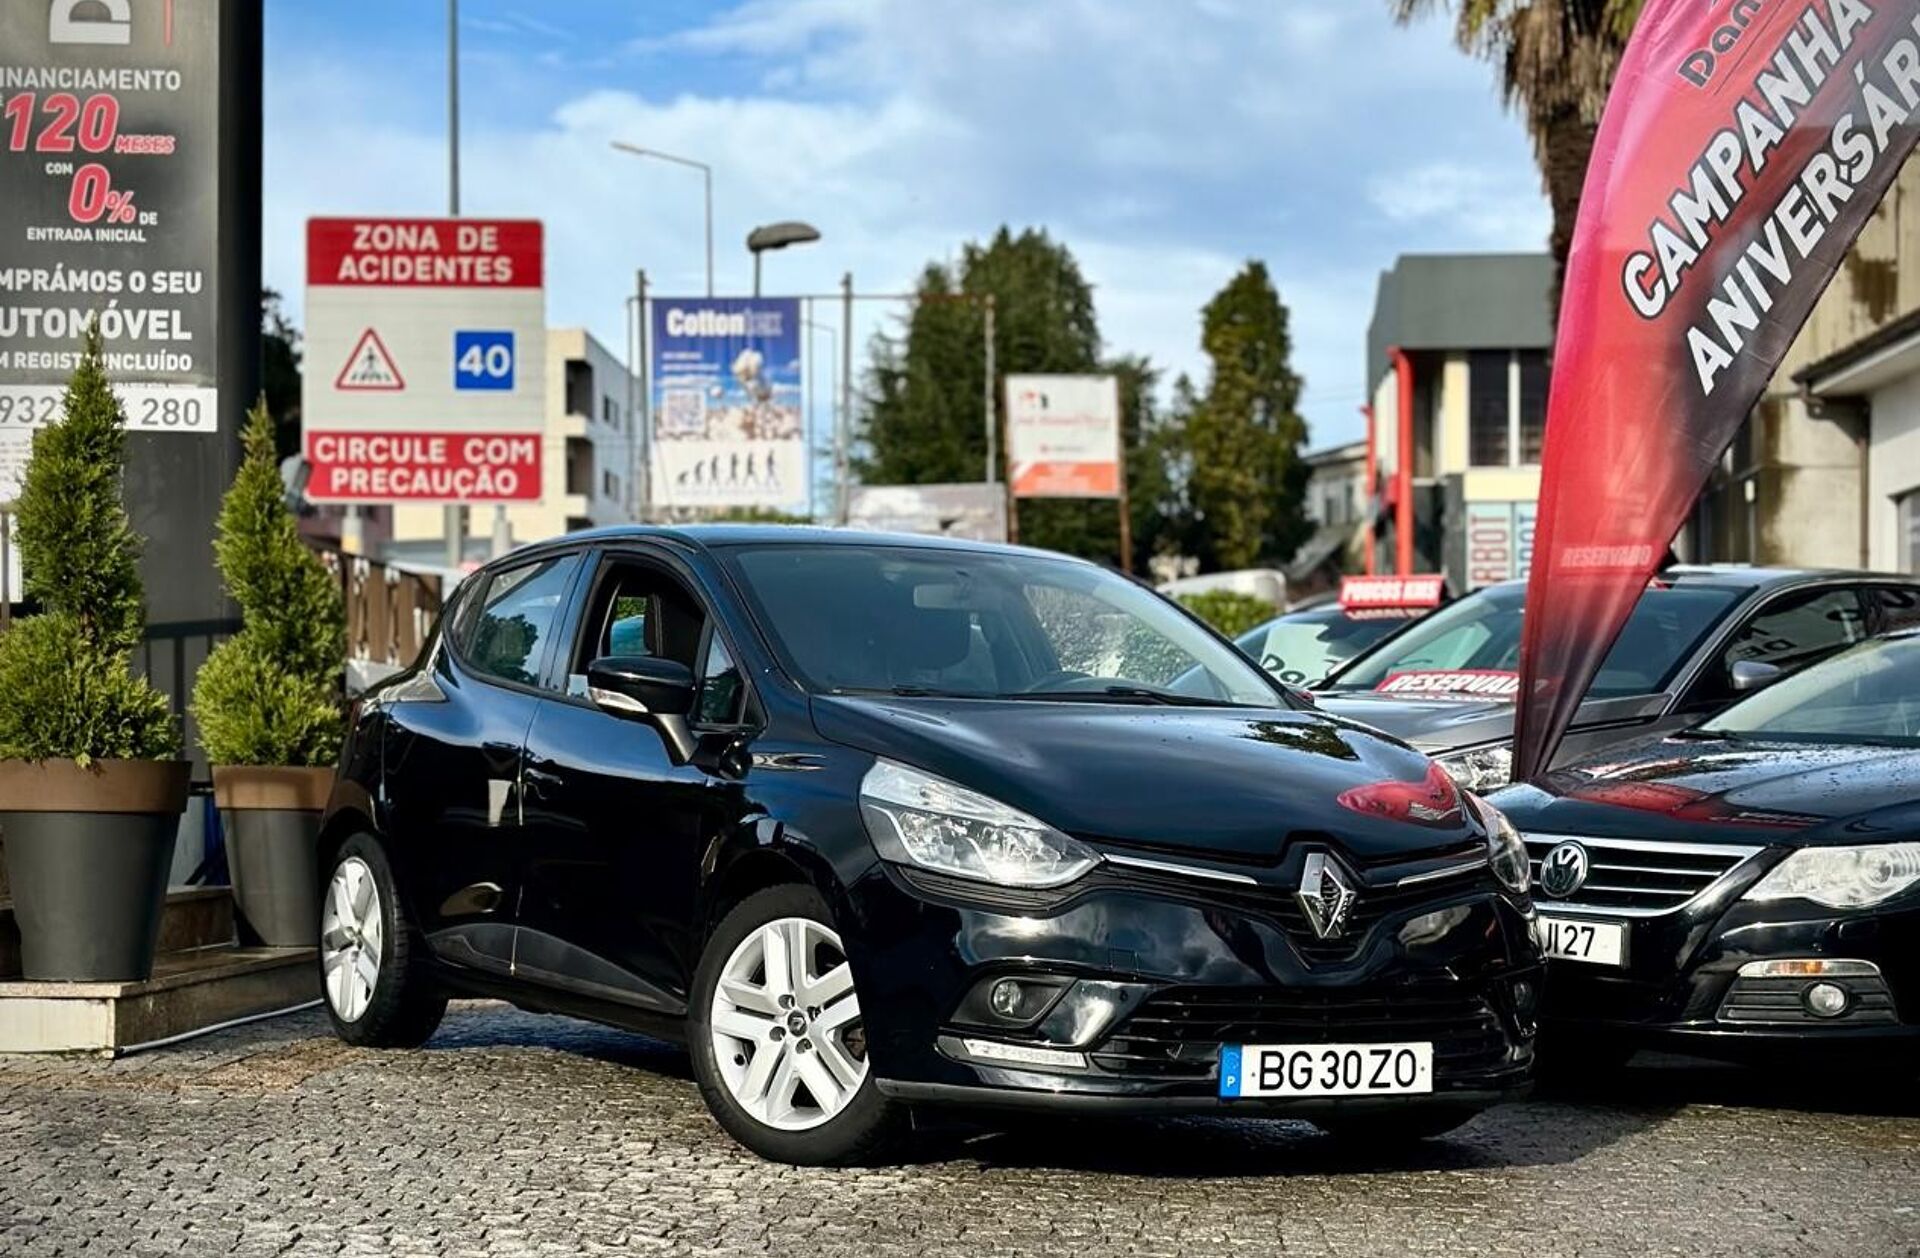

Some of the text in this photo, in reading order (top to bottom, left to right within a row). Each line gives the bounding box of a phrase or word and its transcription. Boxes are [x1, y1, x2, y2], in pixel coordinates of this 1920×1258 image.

[4, 92, 119, 153] 120
[1624, 0, 1873, 317] CAMPANHA
[1687, 13, 1920, 395] ANIVERSÁR
[139, 212, 158, 225] DE
[27, 228, 146, 242] ENTRADA INICIAL
[353, 226, 498, 251] ZONA DE
[338, 256, 513, 282] ACIDENTES
[129, 273, 146, 293] O
[152, 272, 201, 294] SEU
[458, 344, 511, 377] 40
[141, 398, 200, 426] 280
[315, 437, 534, 464] CIRCULE COM
[331, 466, 517, 497] PRECAUÇÃO
